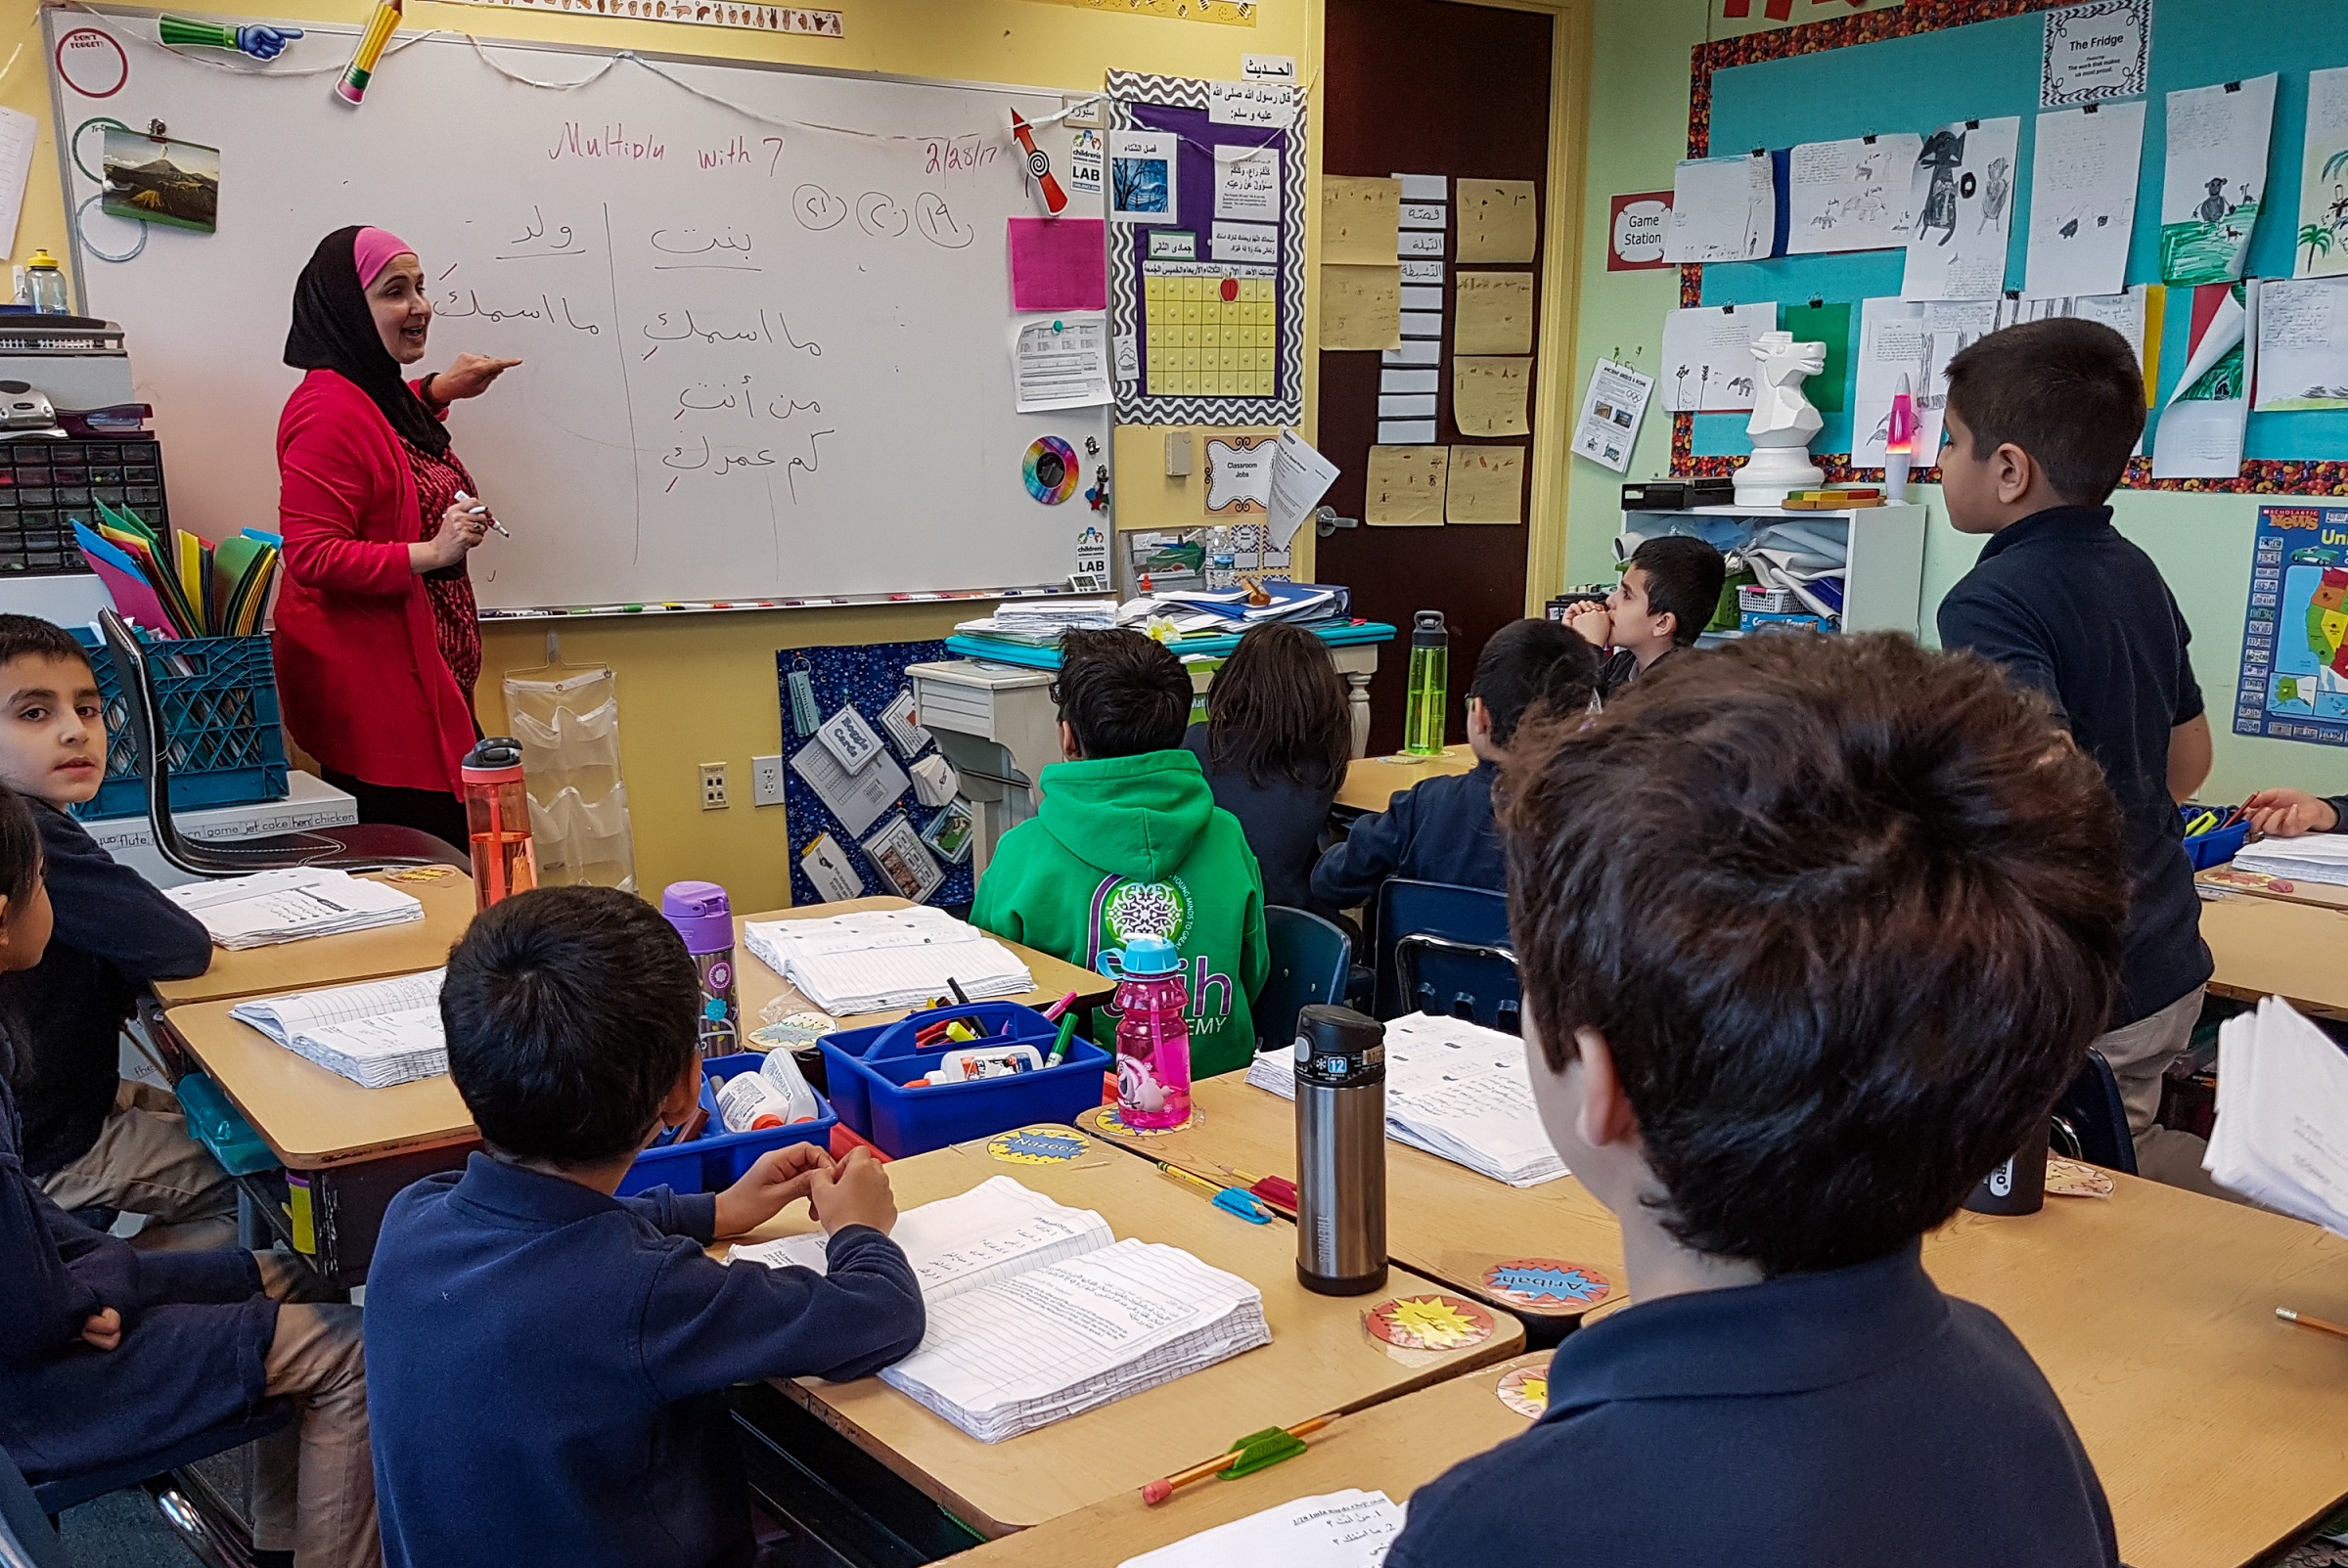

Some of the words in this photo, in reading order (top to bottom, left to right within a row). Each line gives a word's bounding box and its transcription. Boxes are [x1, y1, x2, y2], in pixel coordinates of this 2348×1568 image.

[2069, 40, 2088, 51] The
[2091, 34, 2124, 48] Fridge
[1245, 59, 1293, 78] الحديث
[1212, 84, 1222, 96] الله
[1225, 88, 1242, 102] صلى
[1244, 88, 1254, 100] الله
[1256, 90, 1278, 105] رسول
[1279, 92, 1290, 105] قال
[698, 137, 752, 171] with
[762, 137, 784, 178] 7
[1072, 165, 1101, 182] LAB
[511, 204, 573, 250] ولد
[1628, 214, 1660, 229] Game
[651, 226, 752, 261] بنت
[1624, 232, 1662, 246] Station
[563, 297, 600, 336] ما
[779, 312, 823, 357] ما
[769, 393, 822, 421] من
[787, 428, 835, 506] كم
[1078, 560, 1106, 573] LAB
[840, 716, 869, 751] Boggle
[834, 727, 858, 758] Cards
[119, 833, 148, 847] flute
[207, 825, 240, 838] game
[244, 820, 259, 835] jet
[262, 816, 289, 830] cake
[314, 812, 355, 827] chicken
[1173, 875, 1191, 899] YOUNG
[1185, 897, 1195, 919] MINDS
[1186, 919, 1194, 930] TO
[133, 1064, 155, 1077] the
[1330, 1059, 1345, 1073] 12
[1015, 1138, 1079, 1153] Nazeer
[1502, 1275, 1583, 1290] Aribah
